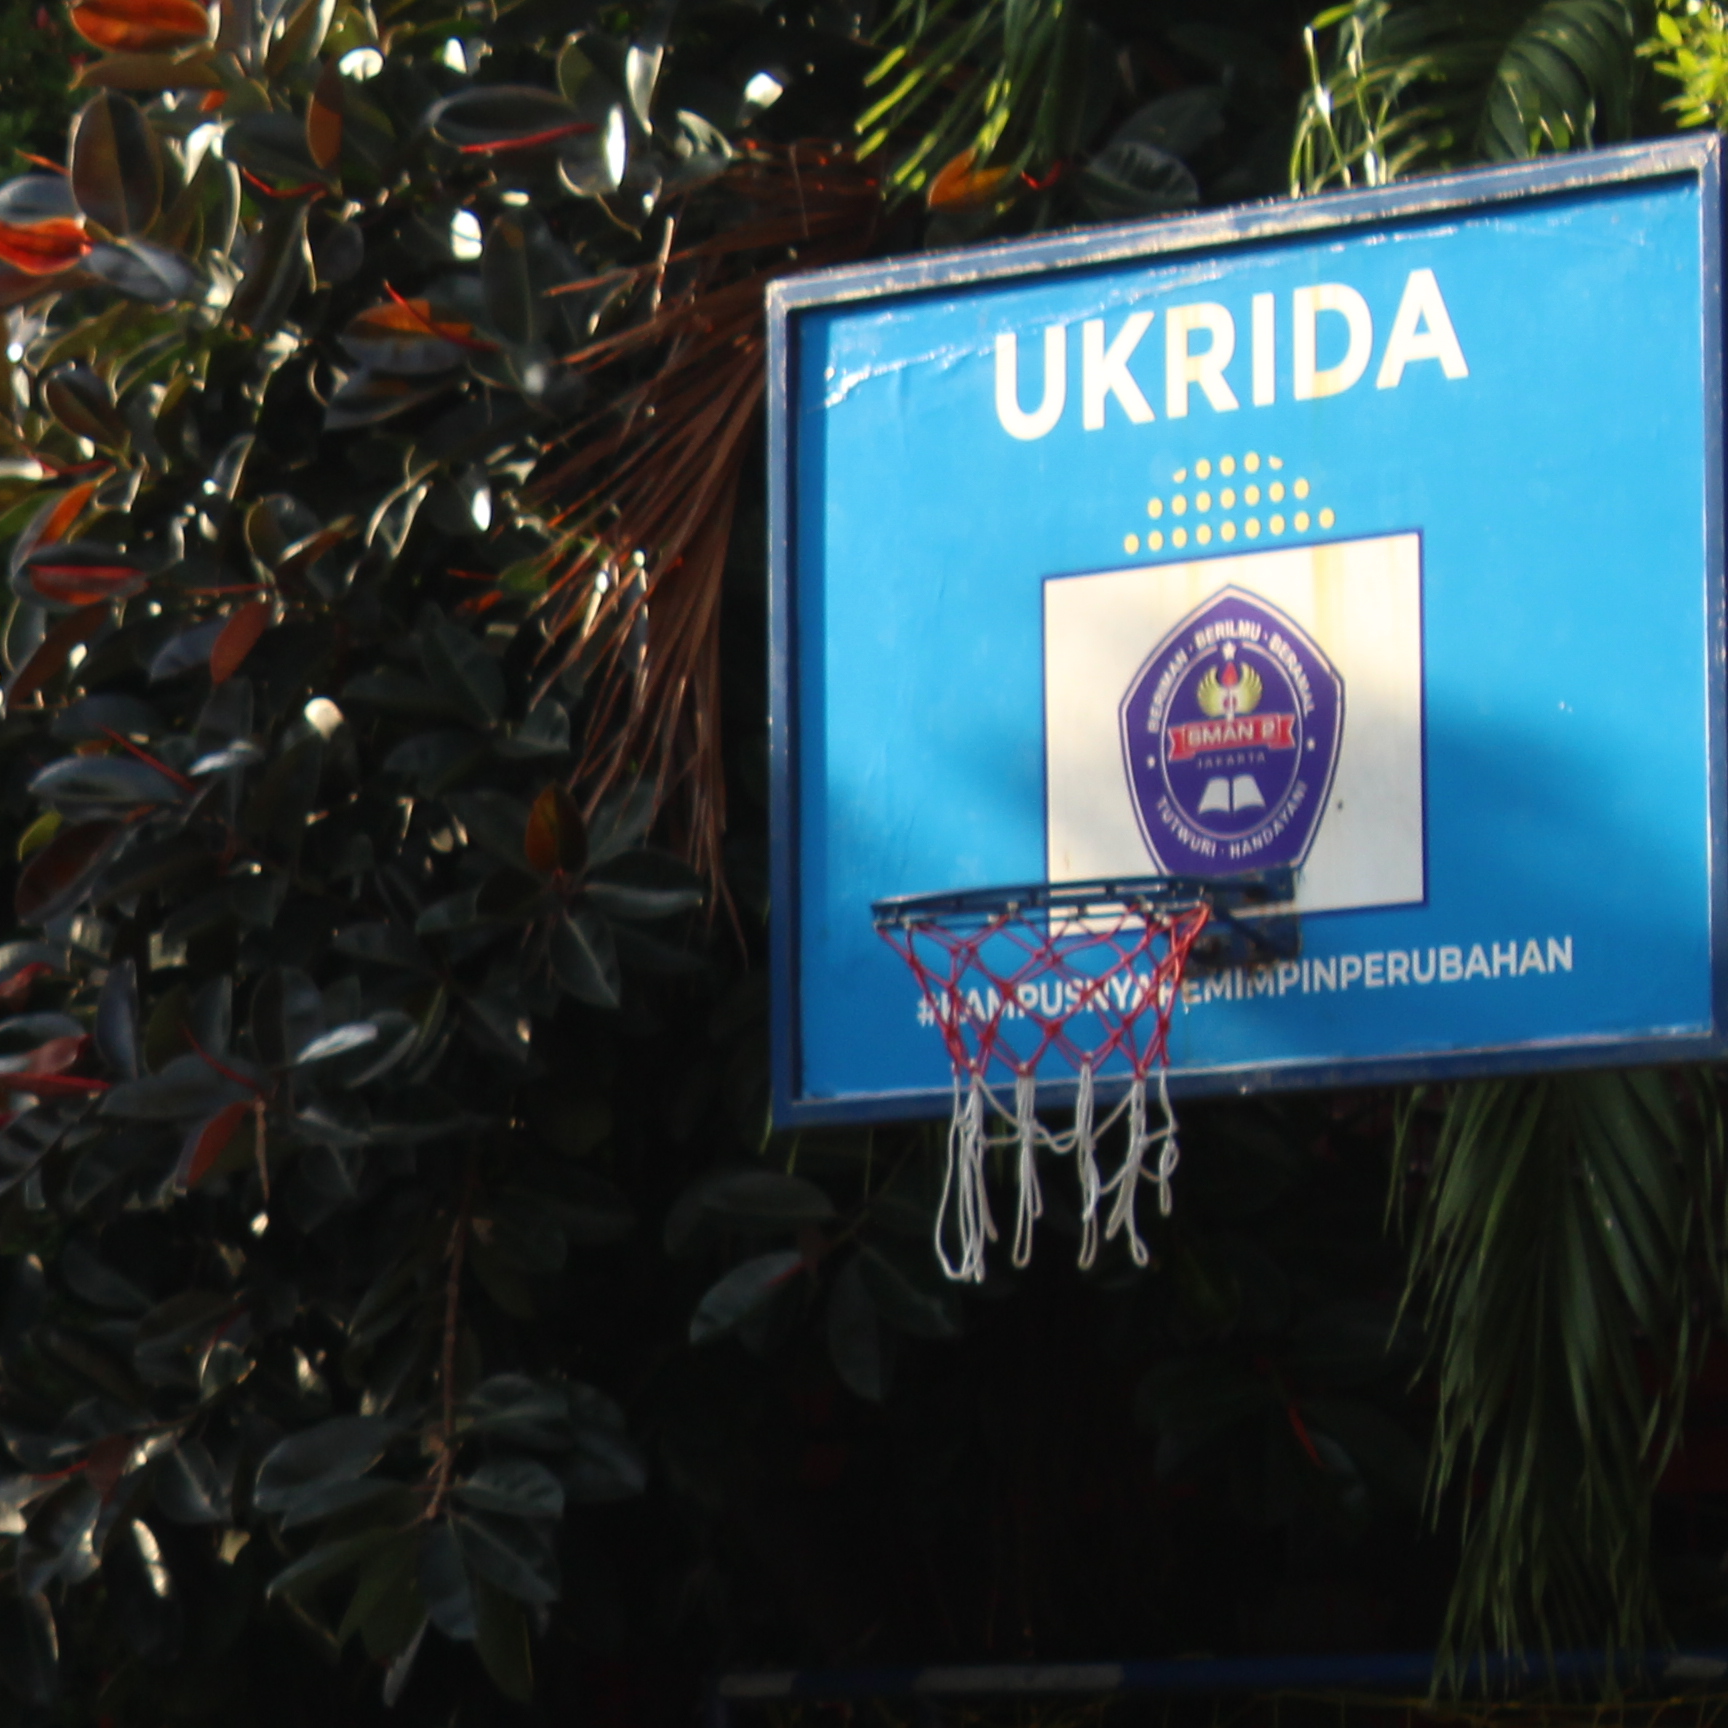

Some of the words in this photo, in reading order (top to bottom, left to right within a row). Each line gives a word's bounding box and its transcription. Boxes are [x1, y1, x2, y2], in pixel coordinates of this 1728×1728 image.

[995, 268, 1469, 441] UKRIDA
[1147, 648, 1190, 734] BERIMAN
[1194, 619, 1262, 650] BERILMU
[1268, 632, 1316, 718] BERAMAL
[1188, 722, 1253, 747] SMAN
[1198, 751, 1266, 769] JAKARTA
